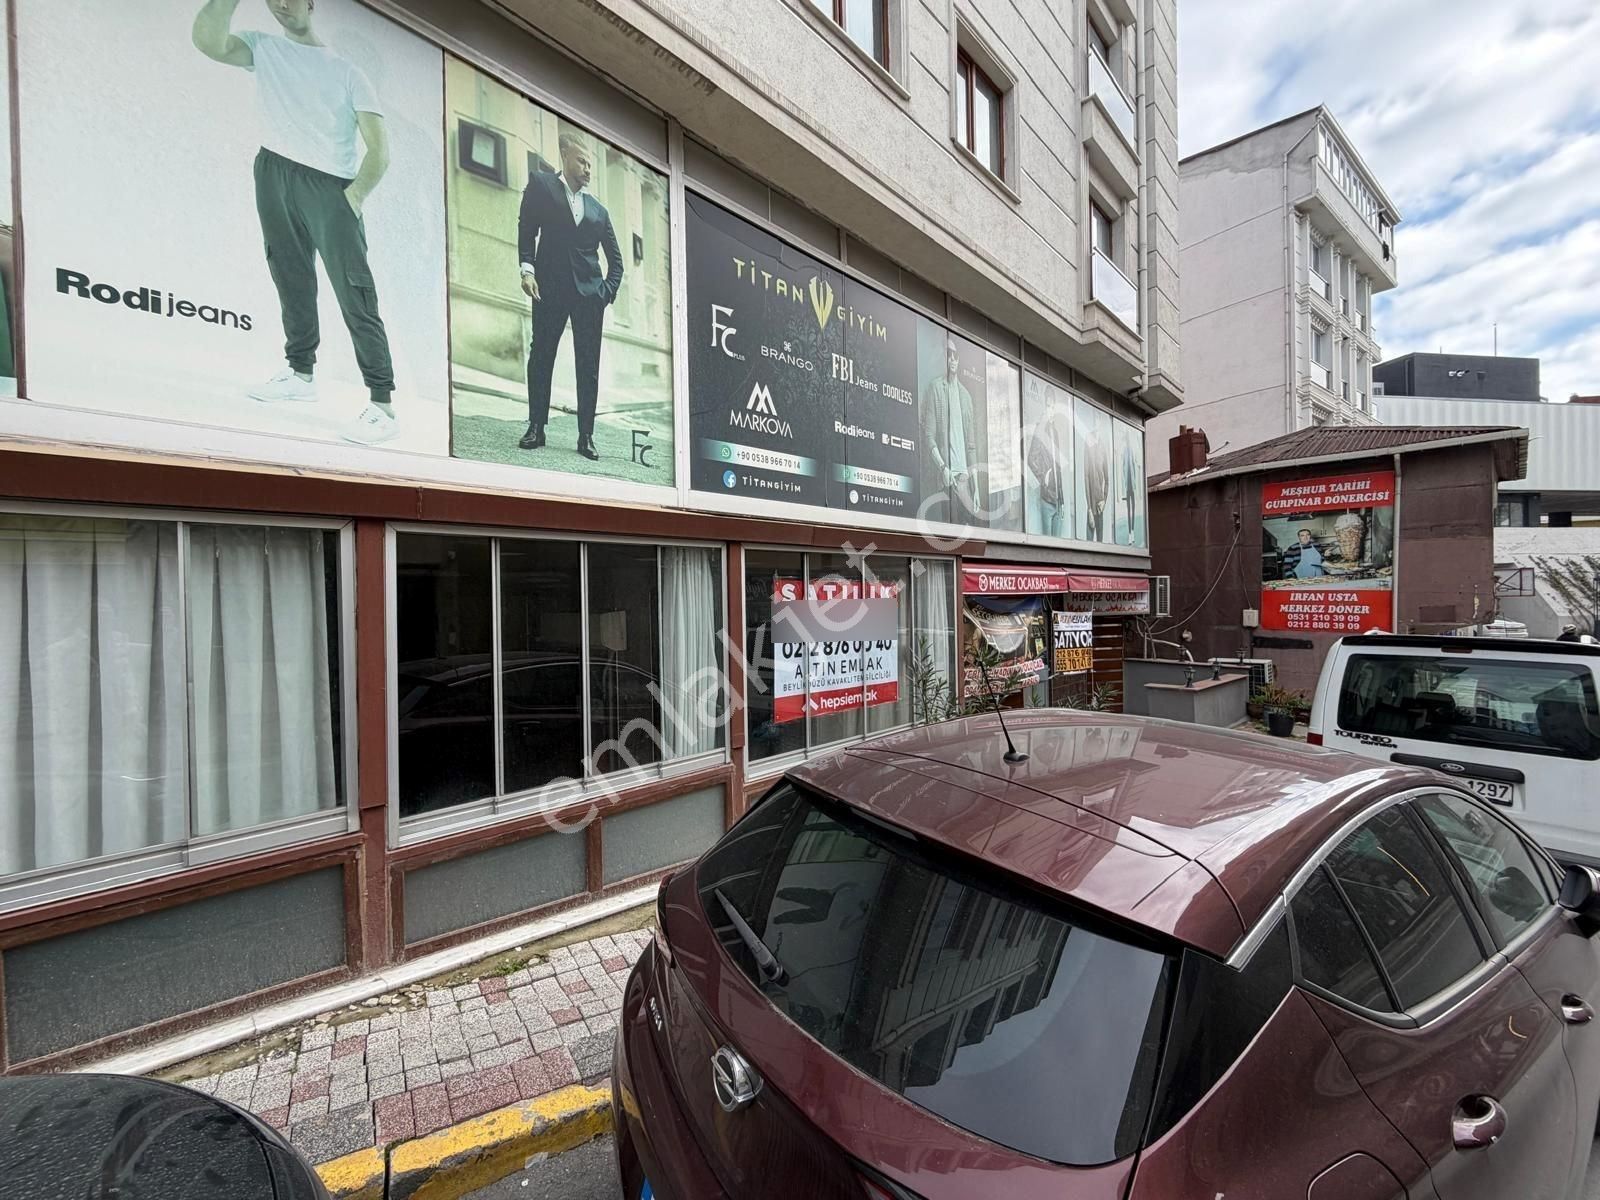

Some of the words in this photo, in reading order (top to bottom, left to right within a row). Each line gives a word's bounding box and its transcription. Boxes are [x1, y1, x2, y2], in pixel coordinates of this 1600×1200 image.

[733, 257, 804, 304] TİTAN
[837, 306, 888, 342] GİYİM
[761, 345, 814, 371] BRANGO
[831, 353, 854, 384] FBI
[730, 409, 793, 439] MARKOVA
[737, 451, 750, 460] +90
[742, 475, 800, 492] TİTANGİYİM
[1328, 478, 1371, 492] TARİHİ
[989, 576, 1016, 590] MERKEZ
[1328, 593, 1358, 602] USTA
[1280, 604, 1325, 613] MERKEZ
[820, 690, 878, 709] hepsiemak
[1334, 729, 1392, 744] TOURNEO
